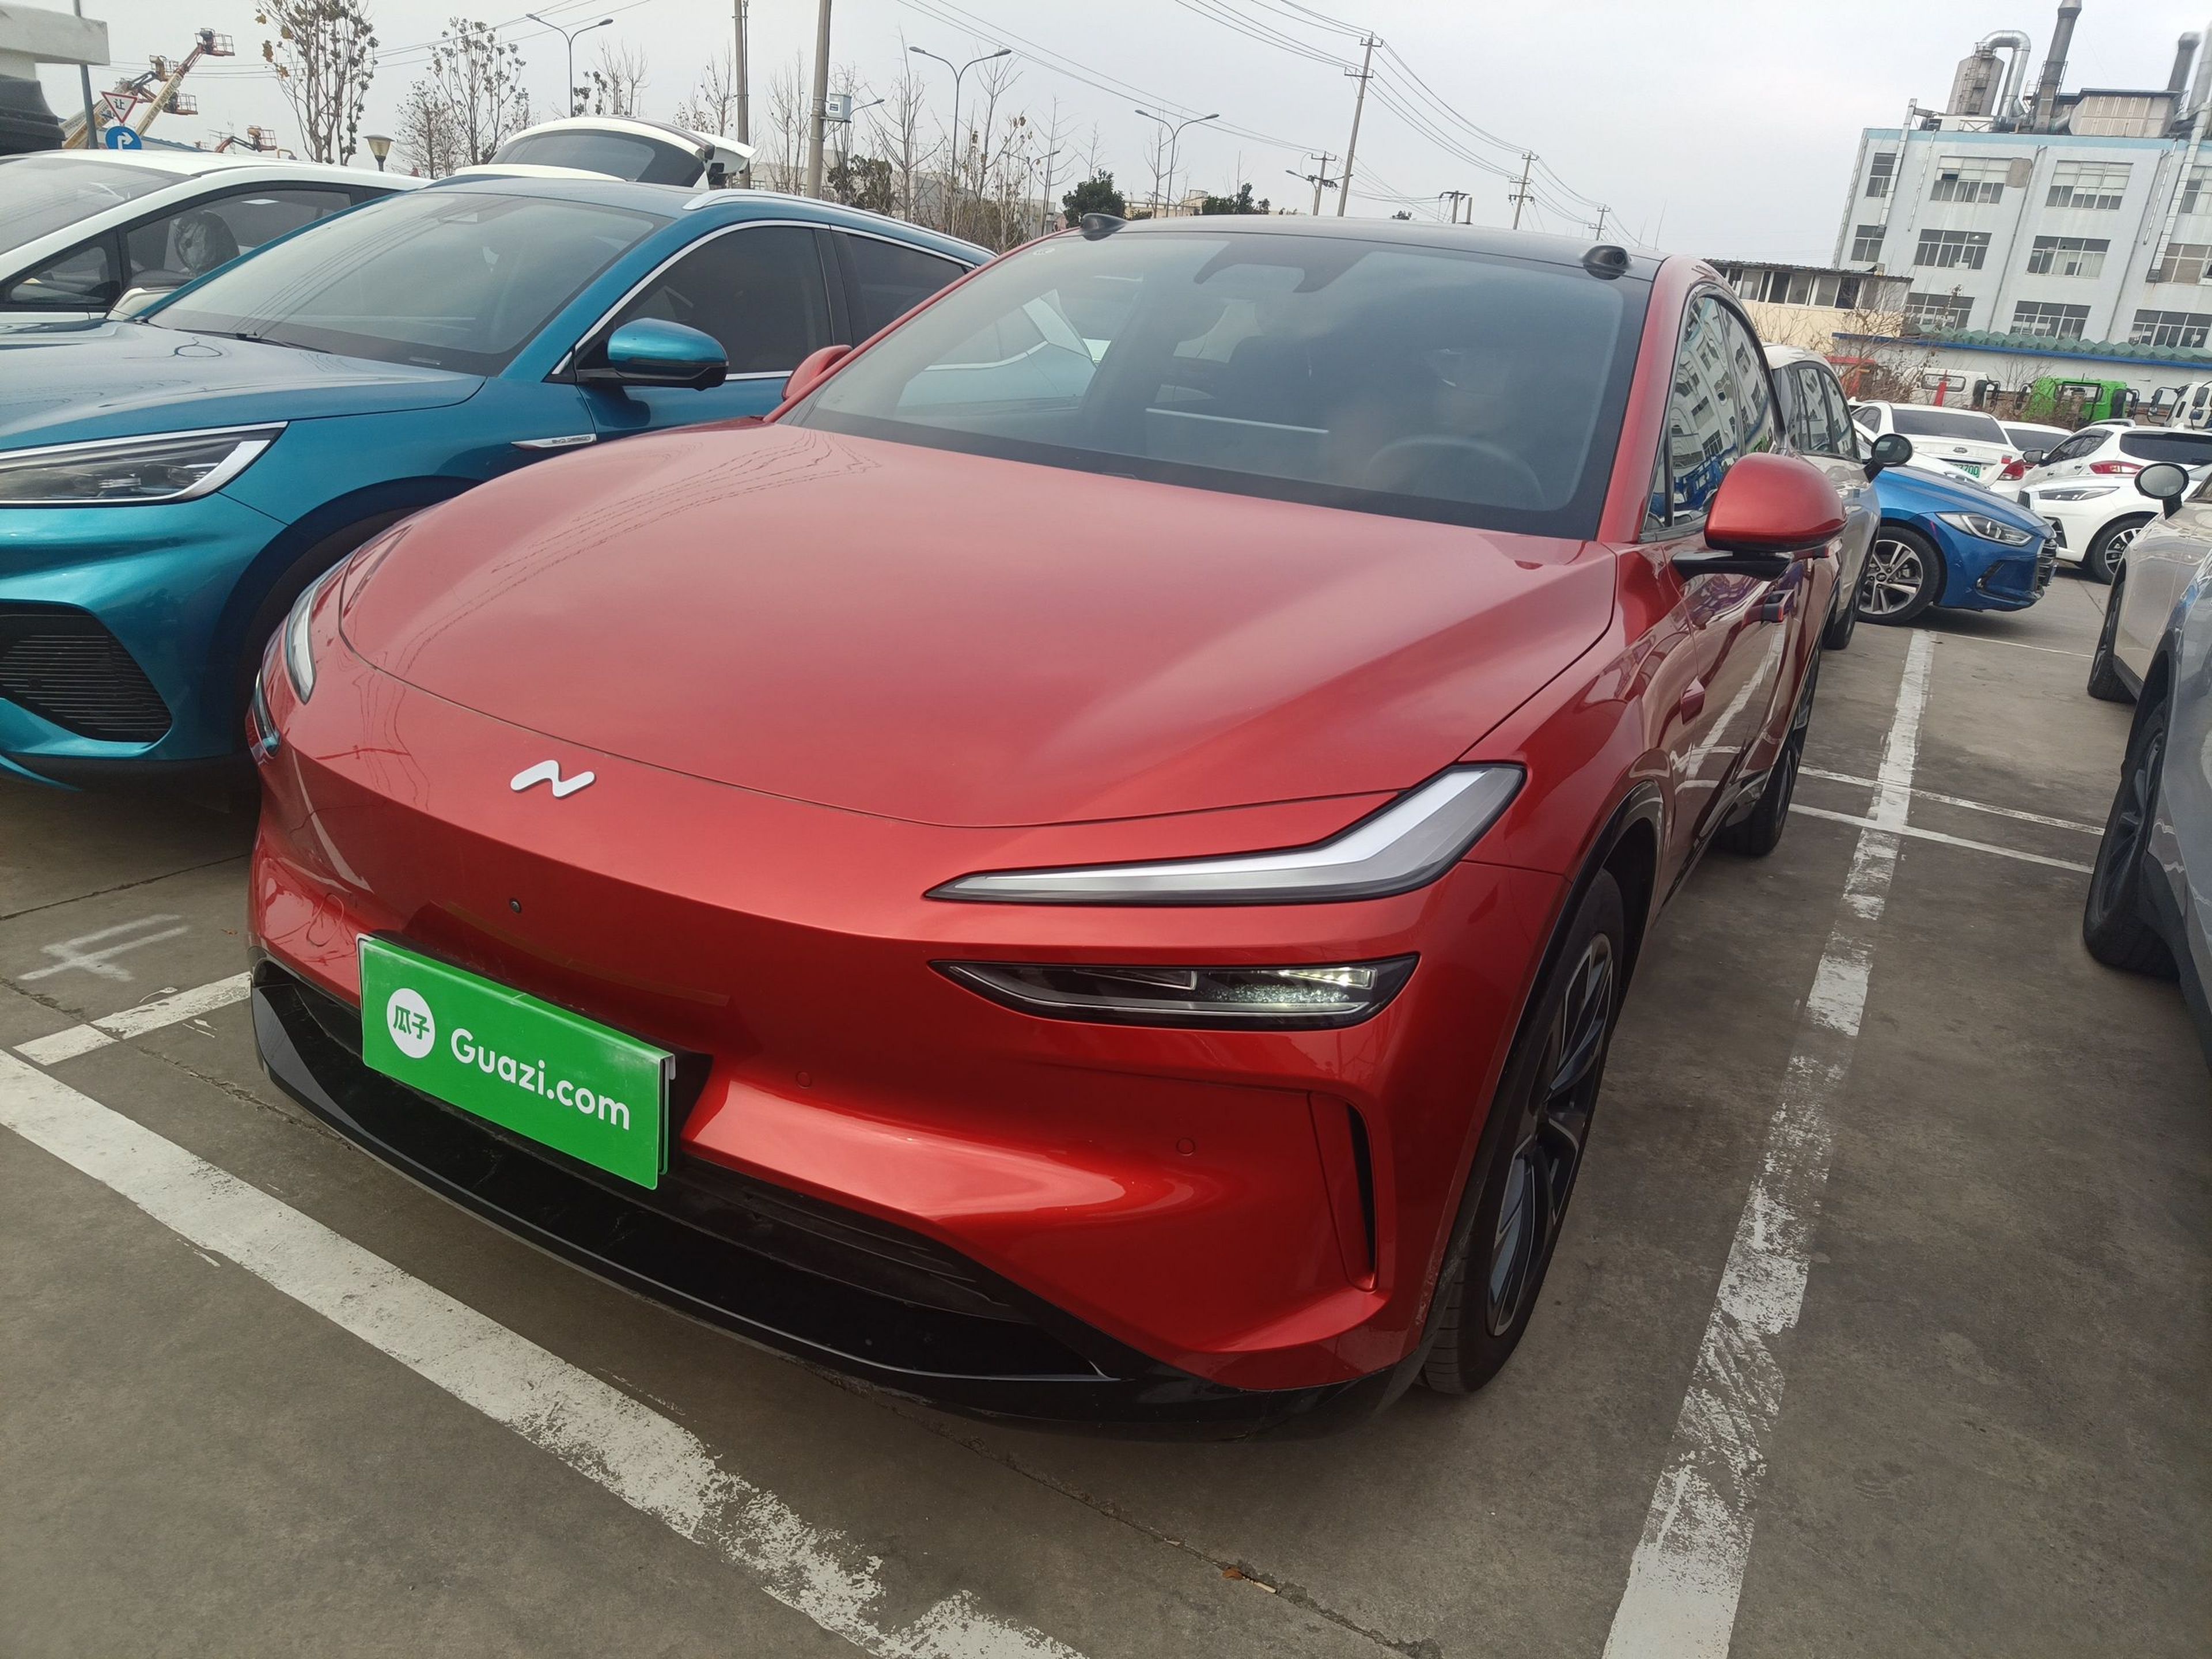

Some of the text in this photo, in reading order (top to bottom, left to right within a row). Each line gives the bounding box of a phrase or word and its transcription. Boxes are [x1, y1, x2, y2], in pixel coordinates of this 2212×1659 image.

[113, 99, 125, 110] 让
[393, 1004, 430, 1040] 瓜子
[450, 1028, 630, 1131] Guazi.com
